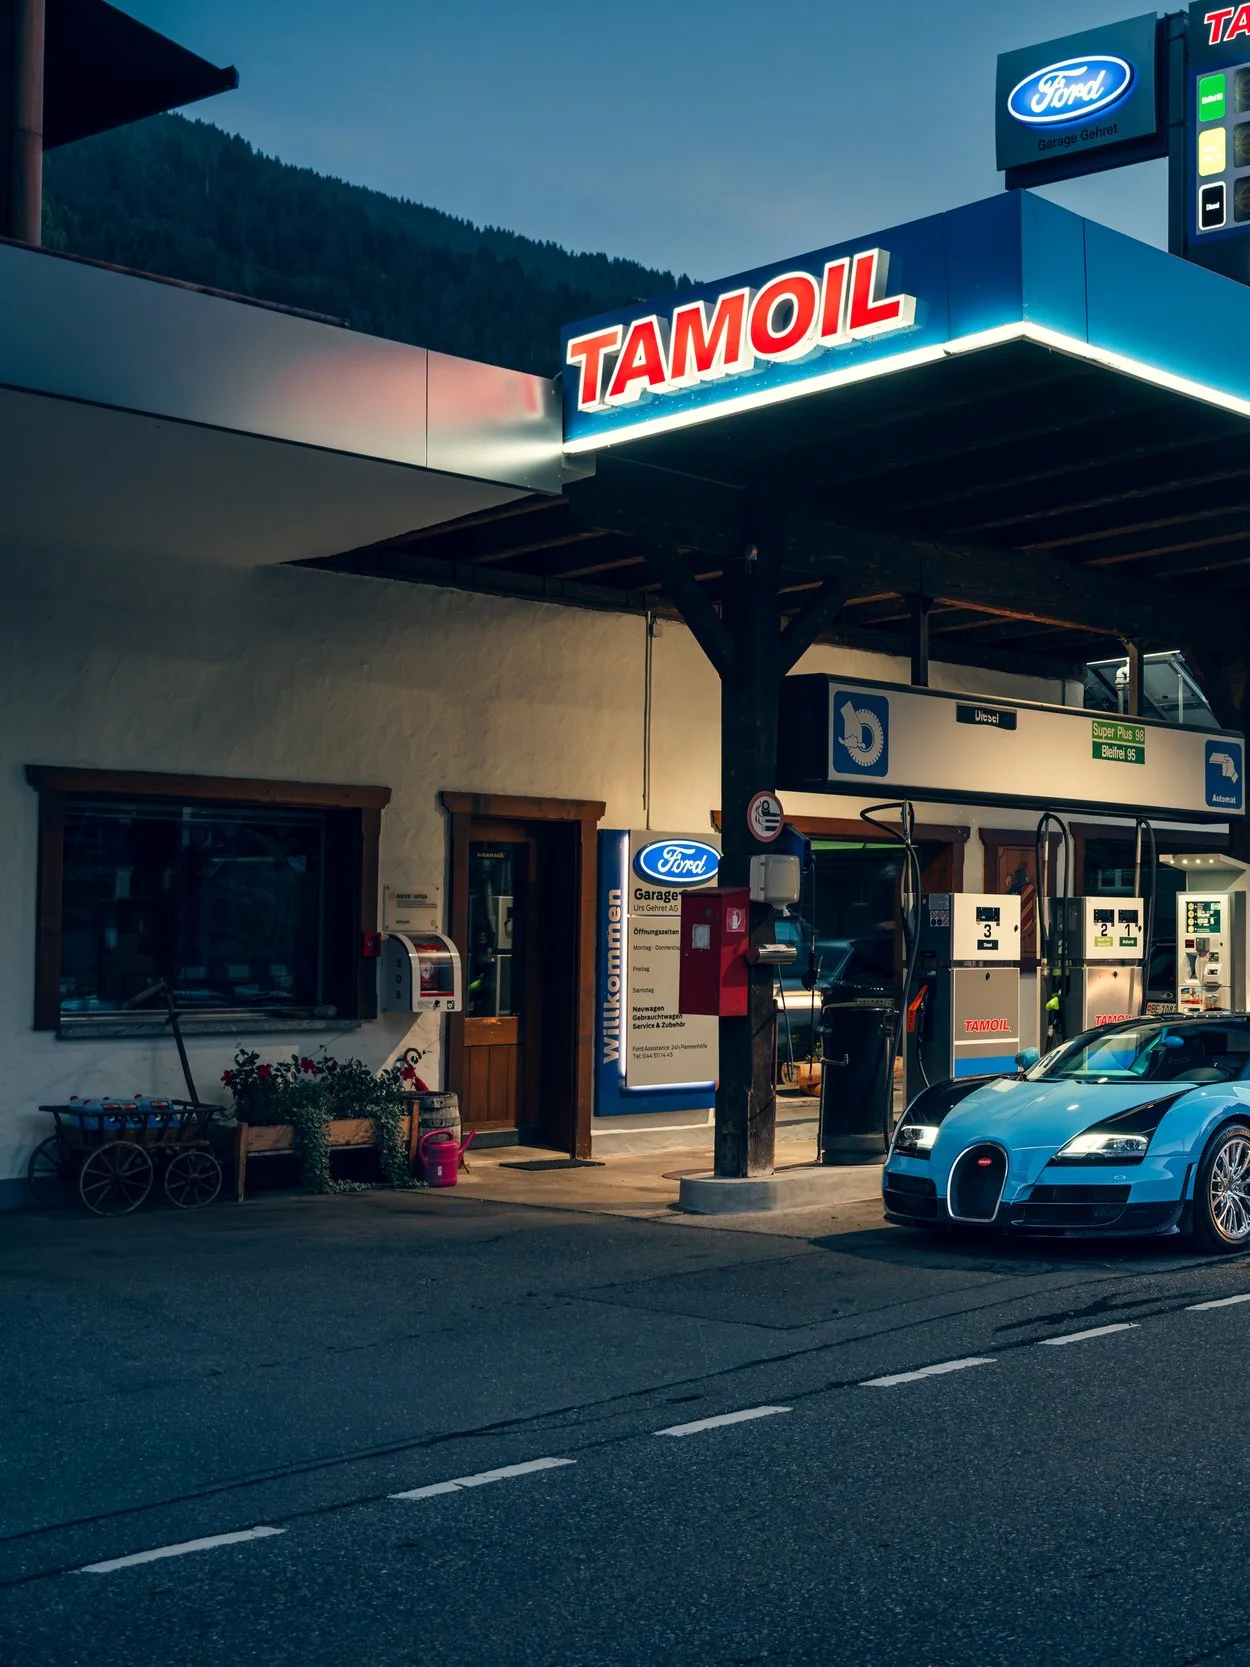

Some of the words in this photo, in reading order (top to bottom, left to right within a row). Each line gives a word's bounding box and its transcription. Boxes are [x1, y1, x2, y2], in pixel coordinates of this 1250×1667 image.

[1030, 65, 1107, 113] Ford
[1038, 134, 1078, 151] Garage
[1080, 122, 1119, 141] Gehret
[566, 247, 917, 412] TAMOIL
[974, 709, 999, 724] Diesel
[1093, 722, 1115, 739] Super
[1117, 726, 1133, 740] Plus
[1135, 729, 1145, 741] 98
[1101, 744, 1126, 760] Bleifrei
[1126, 748, 1136, 761] 95
[657, 846, 708, 874] Ford
[634, 888, 679, 903] Garage
[633, 904, 645, 912] Urs
[645, 904, 668, 912] Gehret
[668, 904, 679, 912] AG
[633, 927, 680, 936] Öffnungszeiten
[983, 923, 992, 938] 3
[1100, 923, 1108, 937] 2
[1124, 923, 1131, 937] 1
[603, 889, 621, 1064] Willkommen
[632, 1013, 683, 1021] Gebrauchtwagen
[632, 1022, 655, 1030] Service
[661, 1021, 686, 1029] Zubehör
[964, 1018, 1010, 1033] TAMOIL
